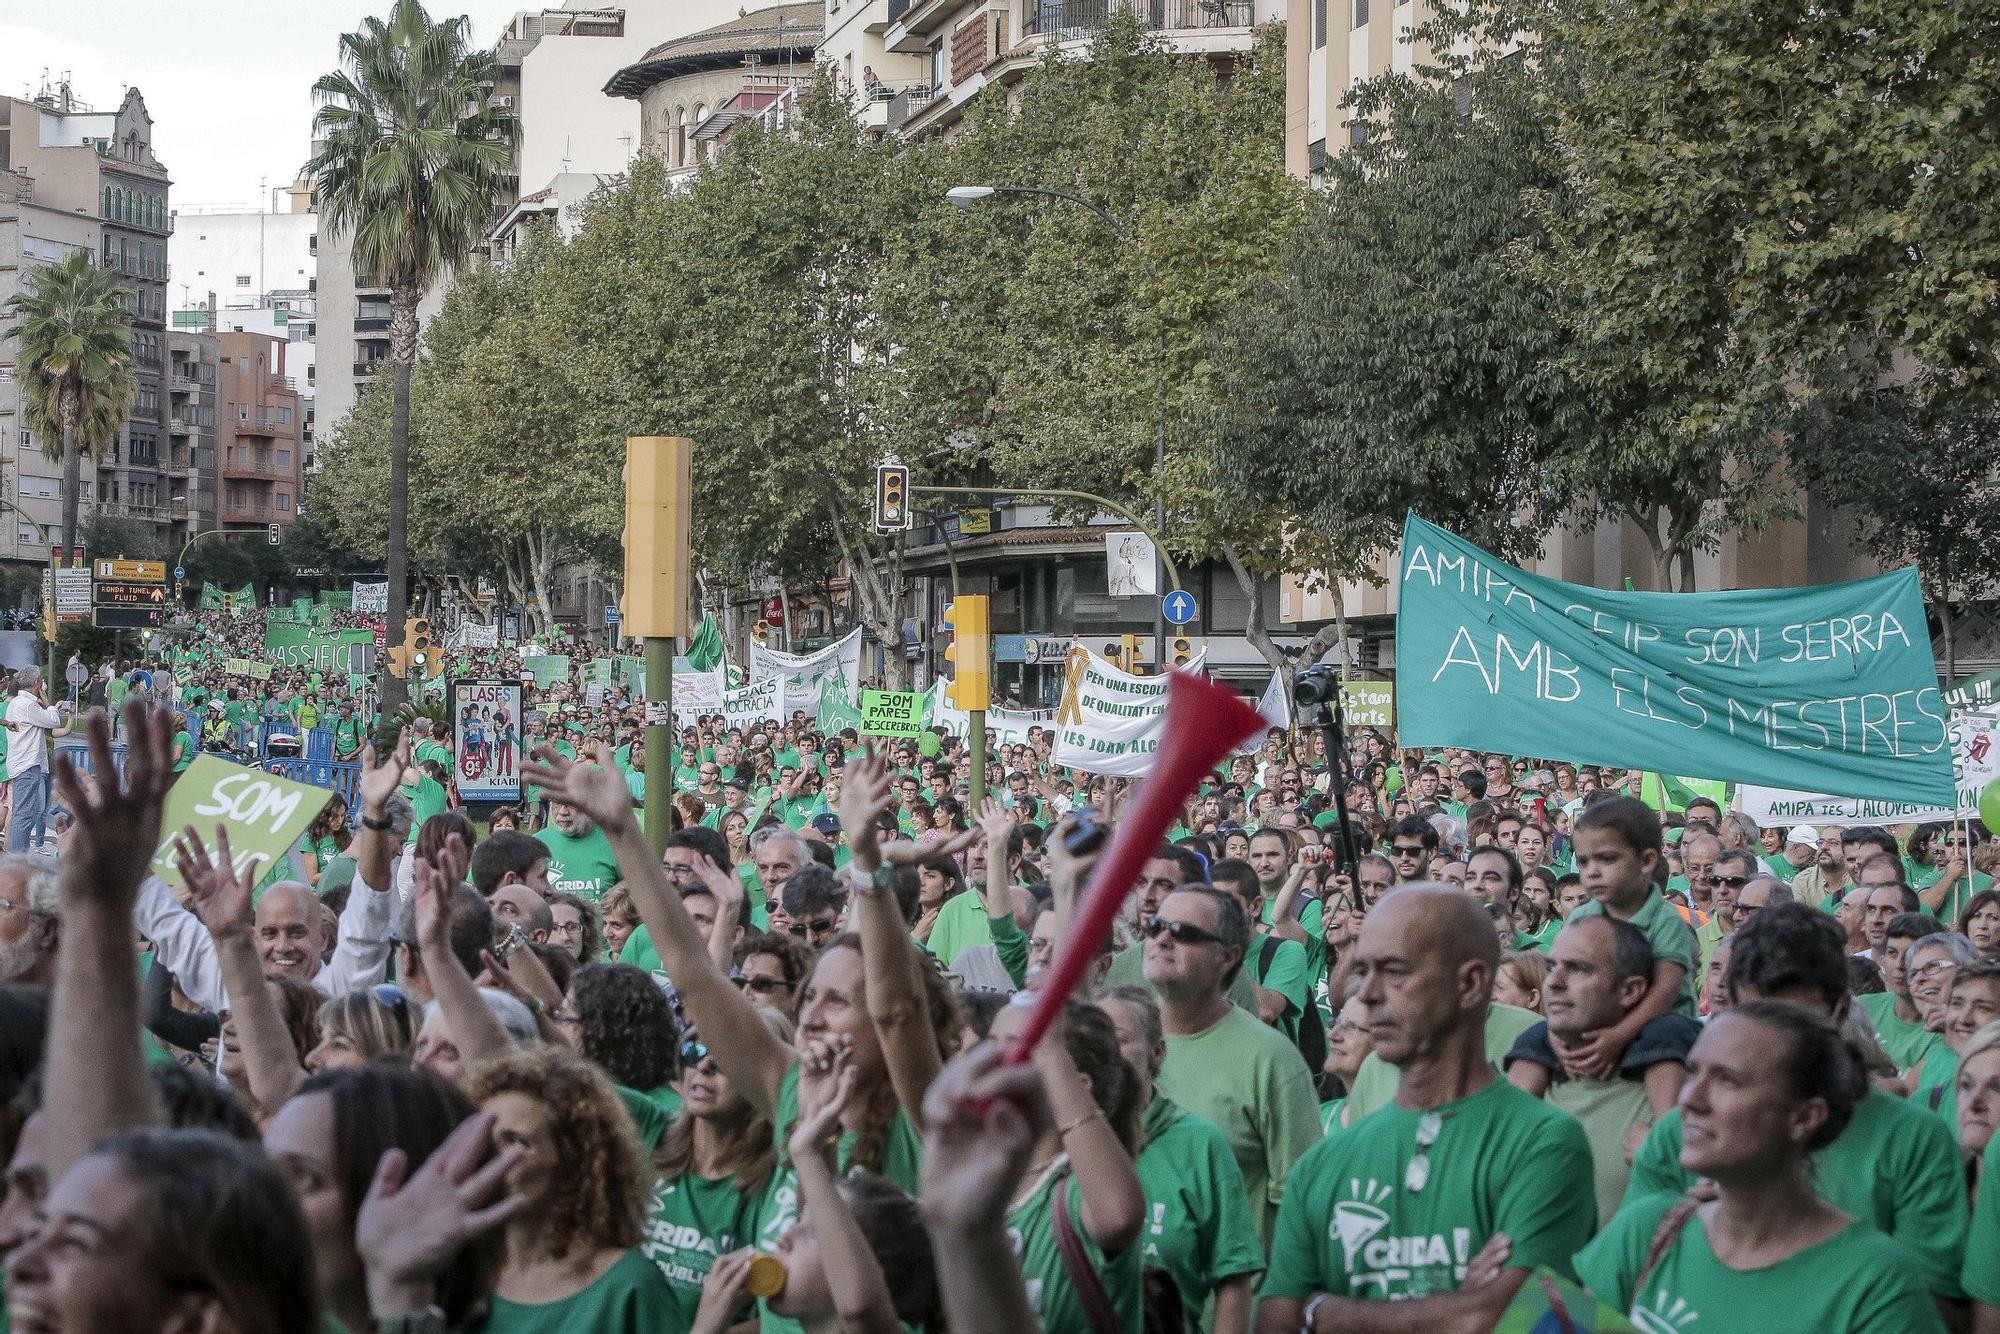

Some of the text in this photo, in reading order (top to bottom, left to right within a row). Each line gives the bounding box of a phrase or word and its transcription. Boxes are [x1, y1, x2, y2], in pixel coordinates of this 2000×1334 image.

[1404, 544, 1536, 613] AMIPA
[1684, 627, 1760, 667] SON
[1778, 610, 1912, 664] SERRA
[729, 668, 741, 679] TIL
[1086, 669, 1105, 686] PER
[1105, 678, 1128, 692] UNA
[457, 686, 511, 702] CLASES
[1432, 625, 1582, 702] AMB
[1611, 667, 1709, 730] ELS
[1727, 686, 1947, 758] MESTRES
[880, 694, 913, 708] SOM
[1081, 694, 1096, 709] DE
[1096, 699, 1145, 718] QUALITAT
[1151, 704, 1165, 715] EN
[870, 707, 910, 719] PARES
[1063, 730, 1158, 755] IES JOAN ALC
[490, 778, 518, 786] KIABI
[194, 773, 304, 834] SOM
[1769, 801, 1815, 816] AMIPA
[1821, 805, 1844, 816] IES
[555, 878, 601, 894] CRIDA!
